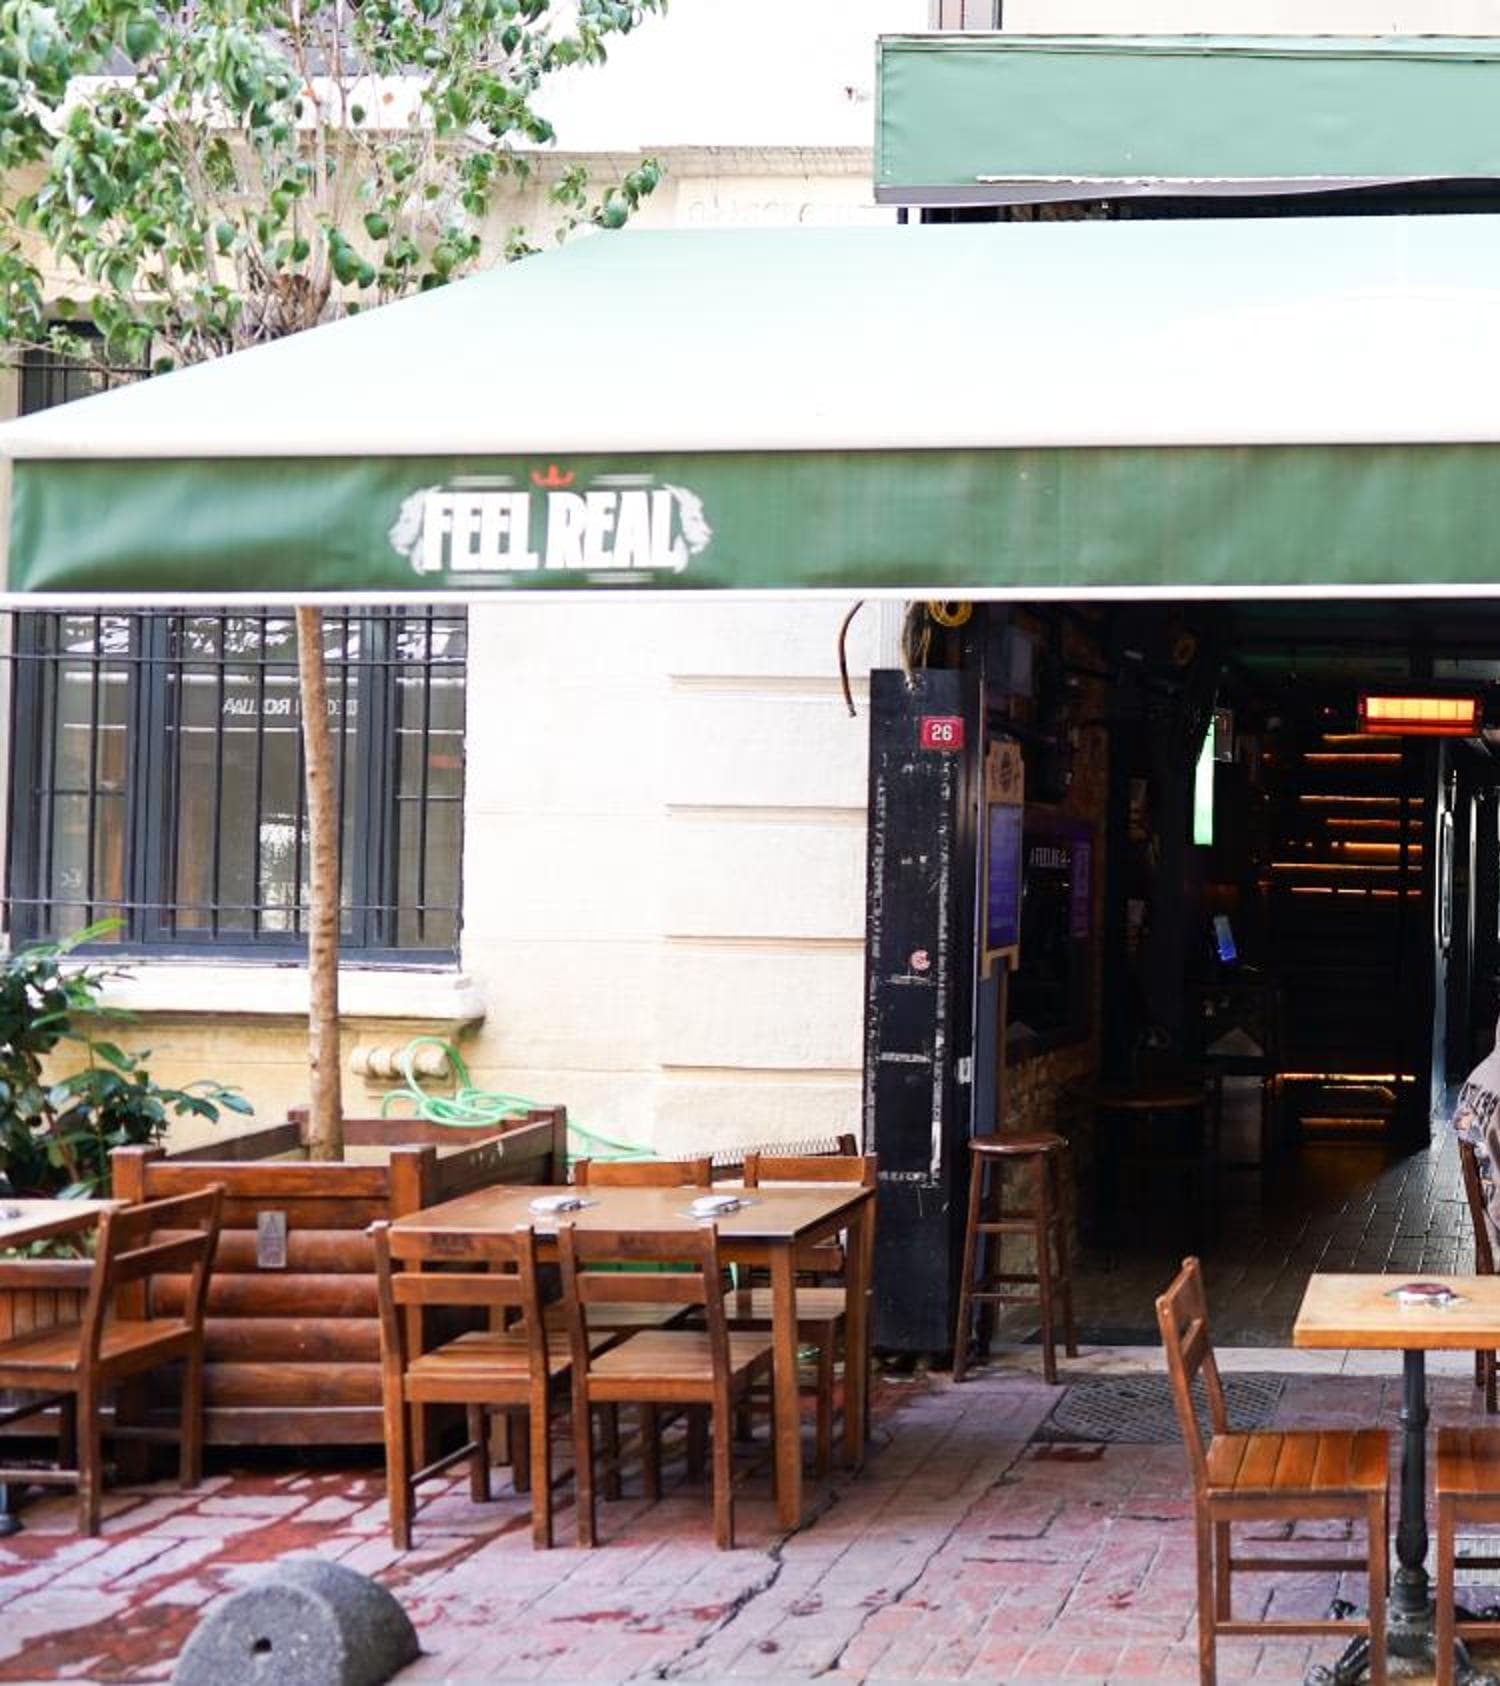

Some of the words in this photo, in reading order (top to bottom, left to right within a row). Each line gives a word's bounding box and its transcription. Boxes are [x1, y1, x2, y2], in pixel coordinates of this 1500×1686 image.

[422, 491, 539, 570] FEEL
[545, 490, 681, 569] REAL
[931, 723, 953, 741] 26
